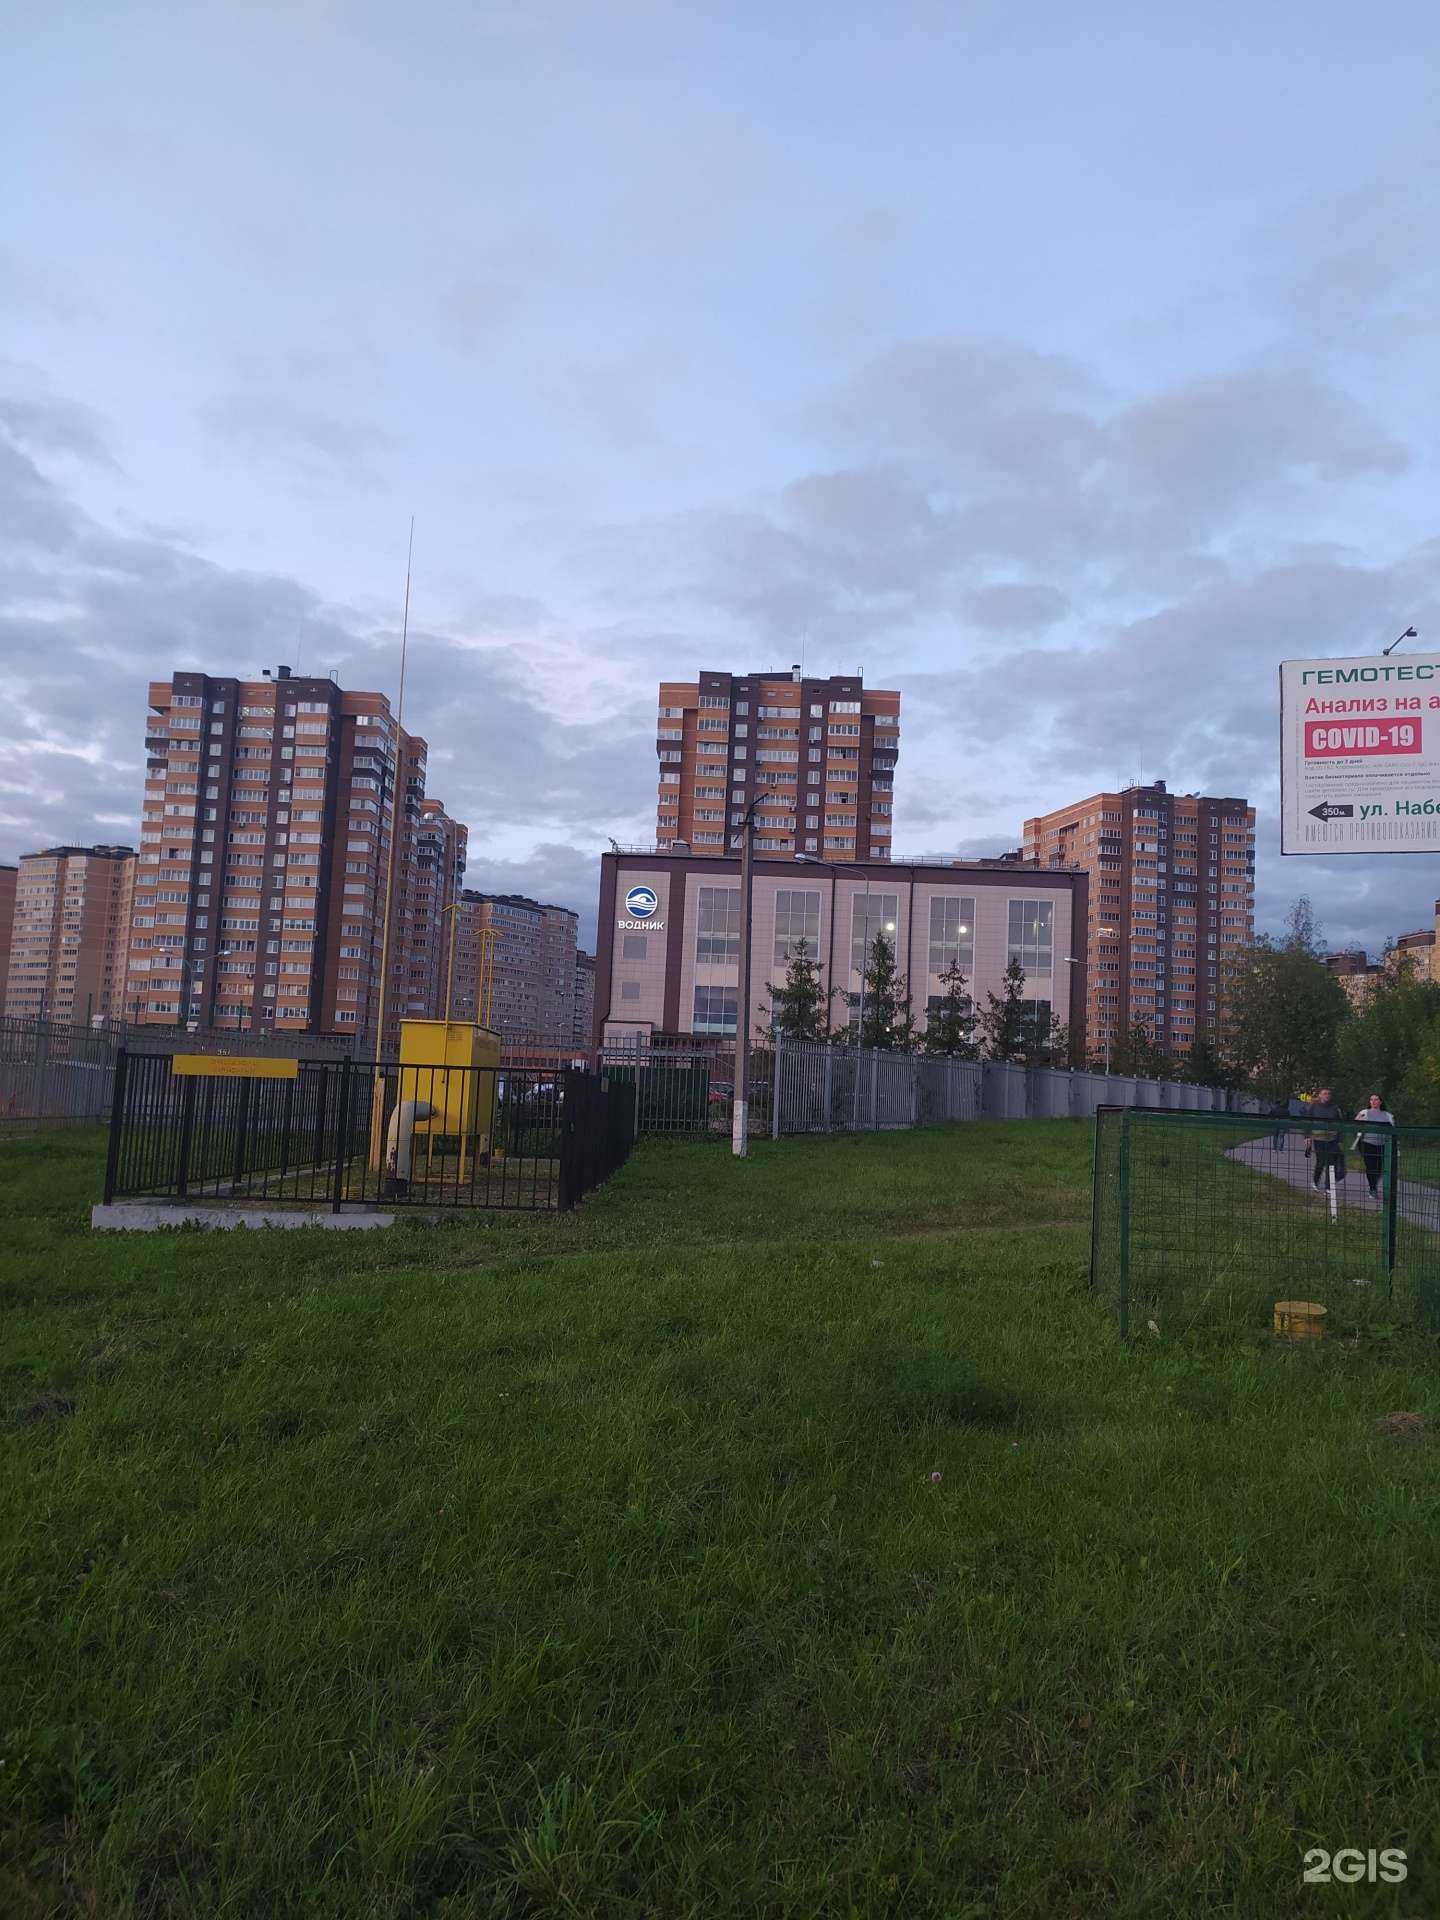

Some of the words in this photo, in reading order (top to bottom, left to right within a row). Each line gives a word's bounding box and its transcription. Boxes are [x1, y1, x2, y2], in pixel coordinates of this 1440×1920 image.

[1305, 697, 1388, 714] Анализ
[1395, 697, 1421, 710] на
[1312, 725, 1414, 750] COVID-19
[1360, 804, 1388, 821] ул.
[618, 920, 665, 930] ВОДНИК
